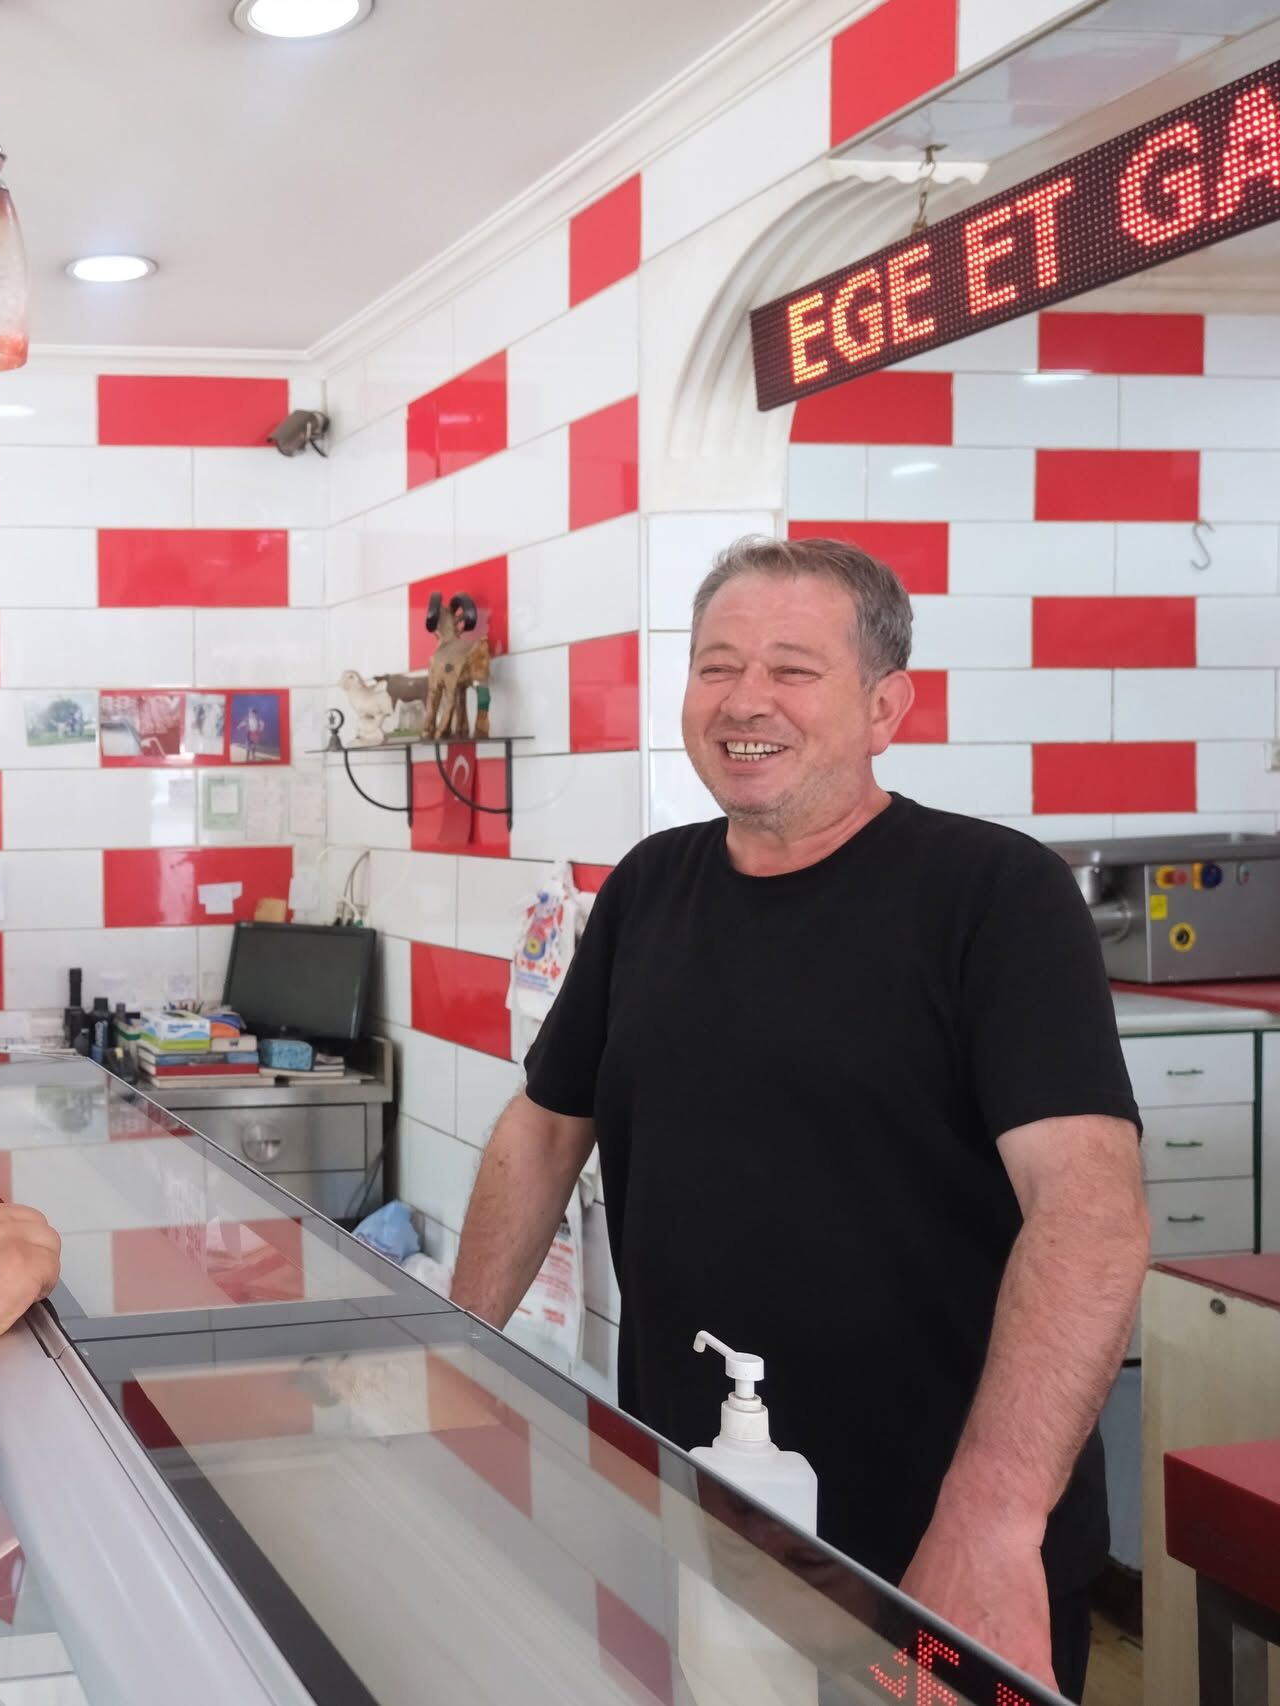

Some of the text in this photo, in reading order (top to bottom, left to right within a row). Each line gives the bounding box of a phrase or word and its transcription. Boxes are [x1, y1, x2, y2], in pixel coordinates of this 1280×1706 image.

[787, 85, 1280, 385] EGE ET GA
